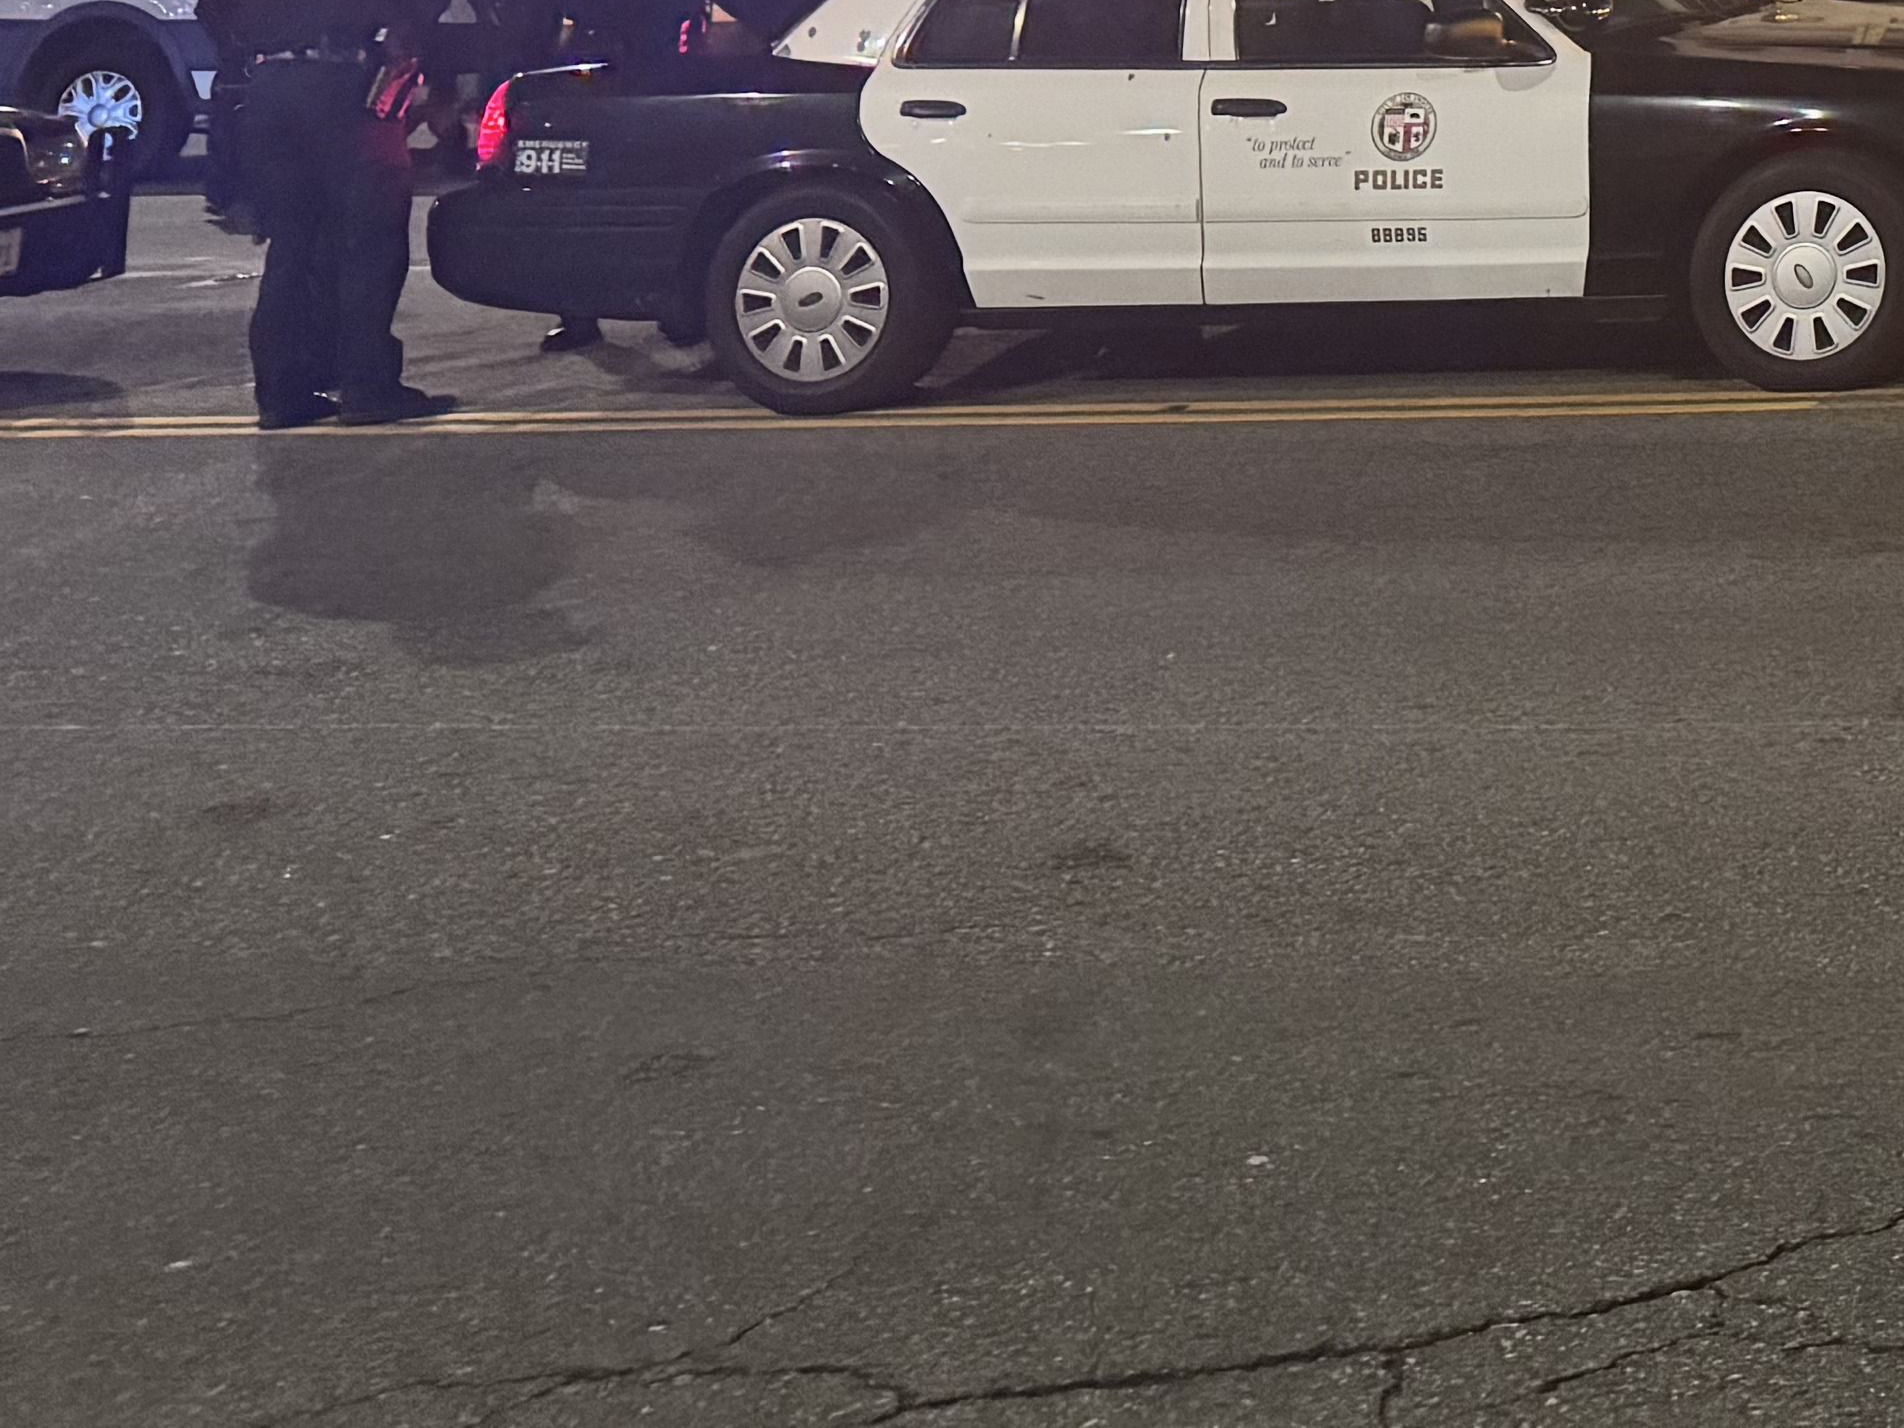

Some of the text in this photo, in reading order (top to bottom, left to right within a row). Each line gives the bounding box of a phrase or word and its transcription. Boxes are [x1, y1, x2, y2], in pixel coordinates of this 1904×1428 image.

[1269, 136, 1317, 155] protect
[1259, 152, 1286, 169] and
[1291, 154, 1305, 169] to
[1354, 169, 1444, 190] POLICE
[1371, 227, 1428, 244] 88895
